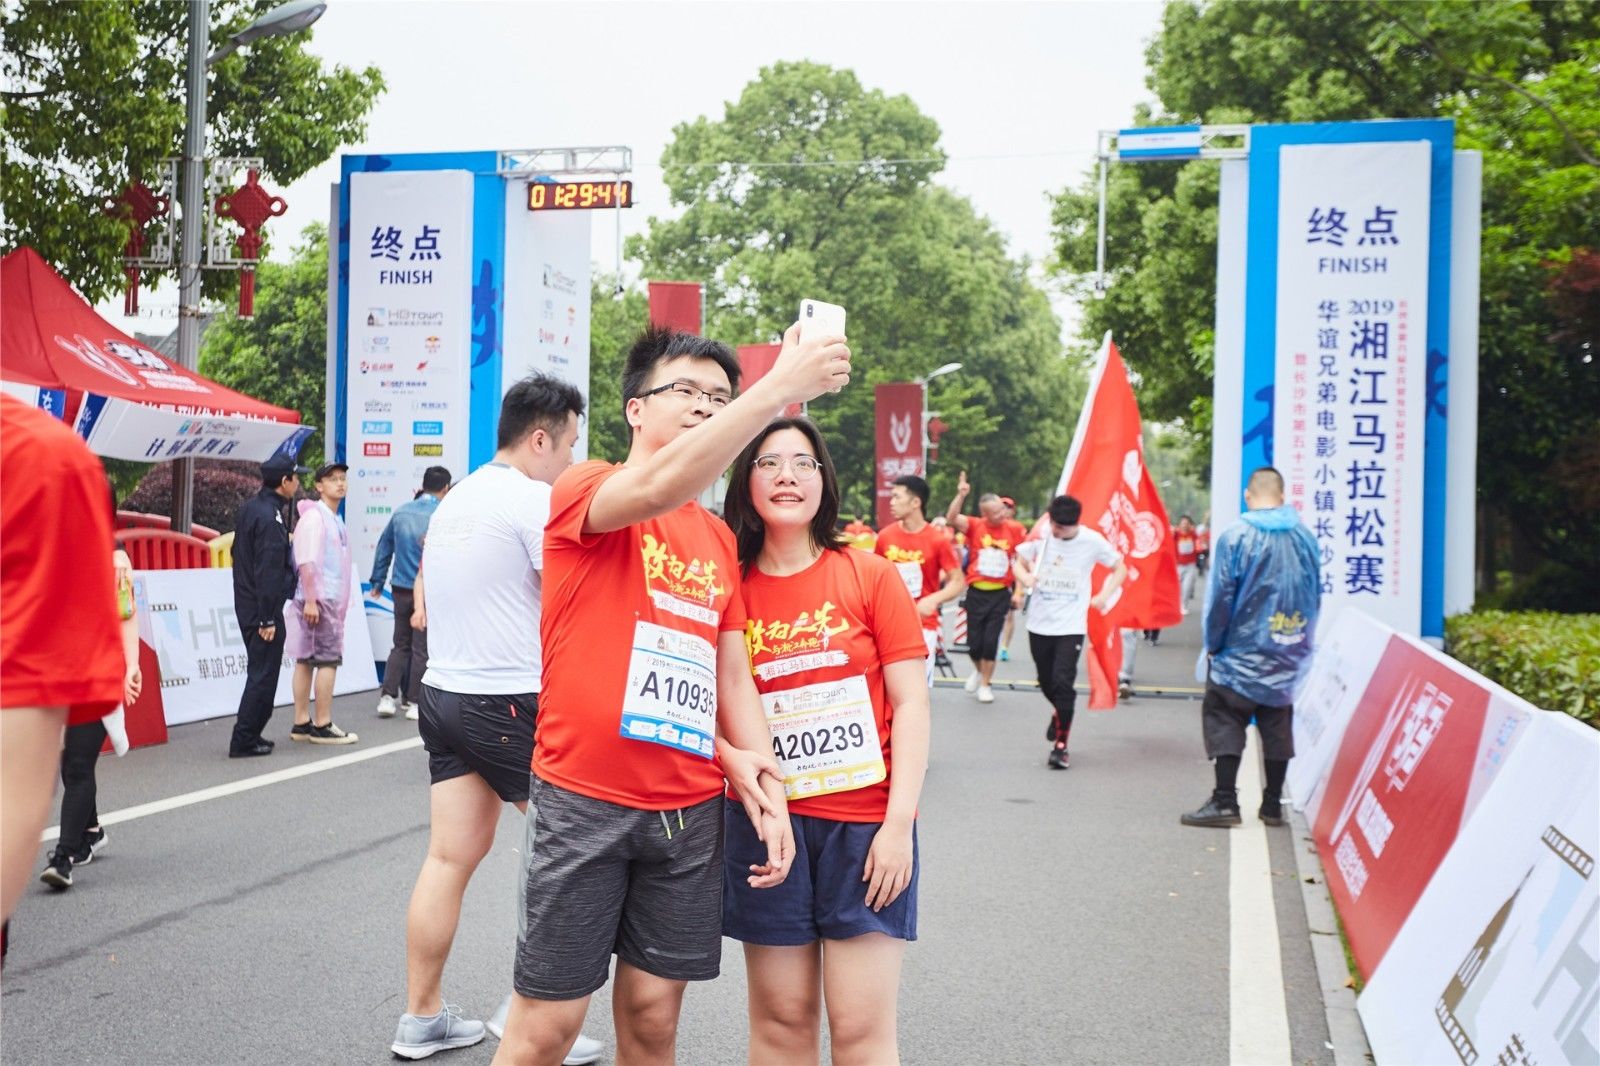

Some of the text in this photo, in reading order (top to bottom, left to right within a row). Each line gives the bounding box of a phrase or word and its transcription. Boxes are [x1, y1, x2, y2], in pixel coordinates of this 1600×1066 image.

[370, 225, 442, 262] 终点
[1307, 205, 1400, 246] 终点
[380, 270, 432, 284] FINISH
[1319, 257, 1388, 273] FINISH
[1348, 299, 1394, 316] 2019
[1345, 320, 1389, 597] 湘江马拉松赛
[640, 671, 714, 717] A10935
[772, 722, 864, 761] A20239
